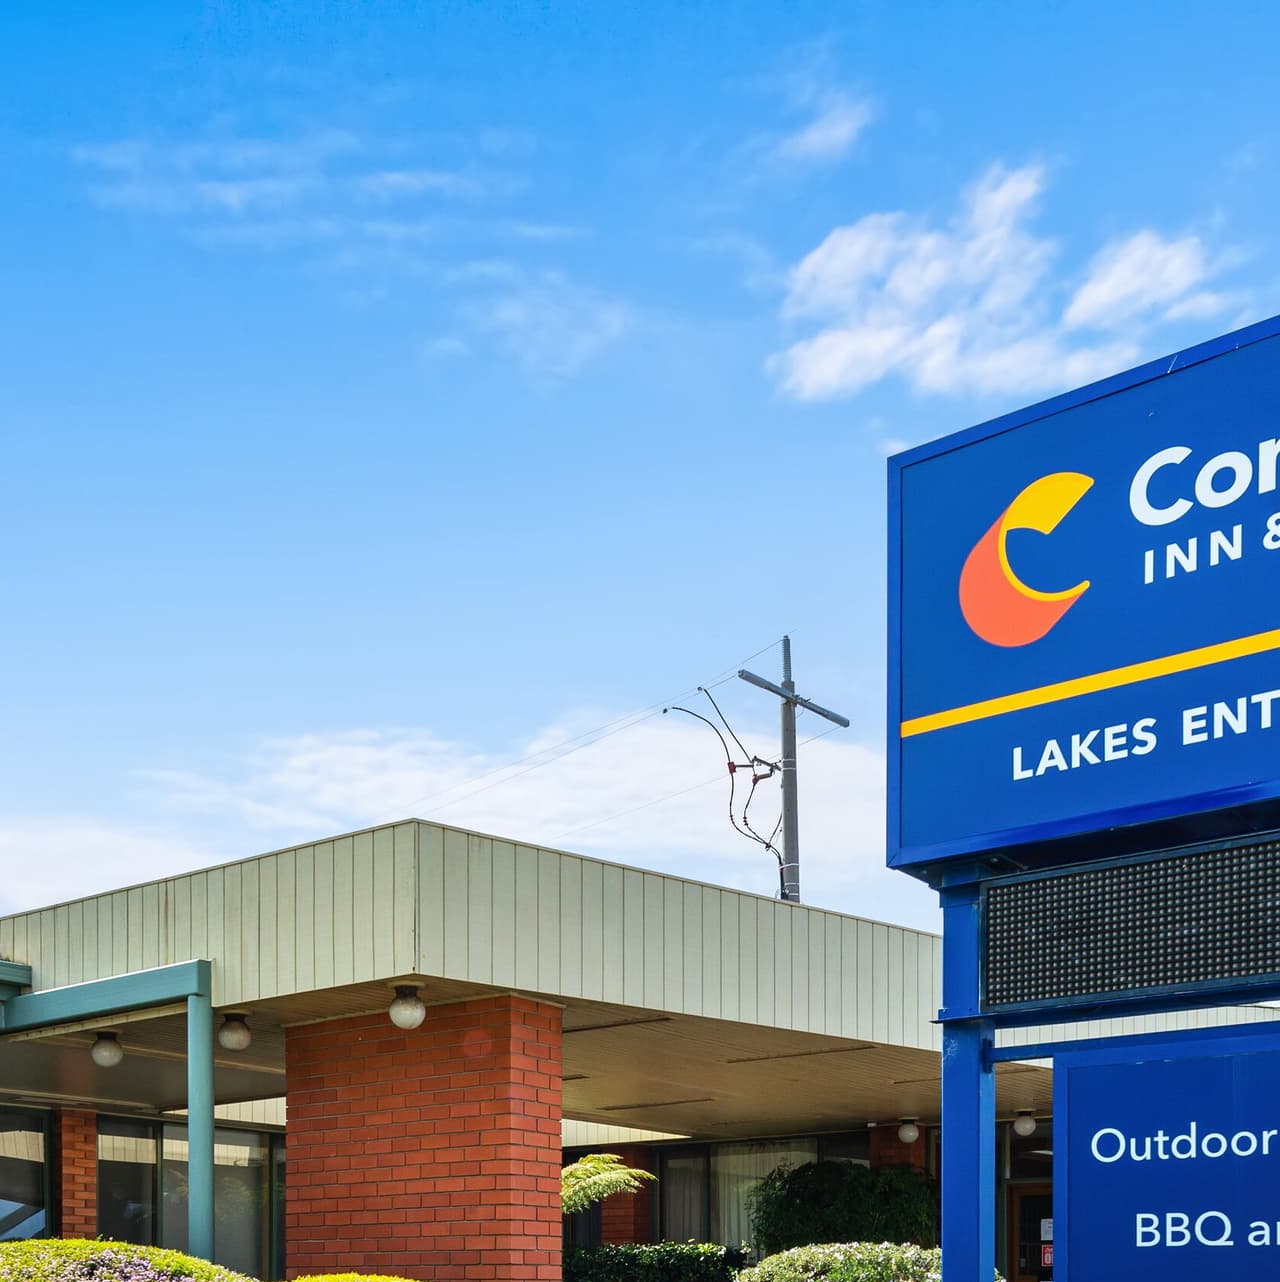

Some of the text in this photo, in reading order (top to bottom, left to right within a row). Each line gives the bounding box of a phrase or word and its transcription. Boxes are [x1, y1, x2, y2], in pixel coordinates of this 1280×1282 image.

[1144, 525, 1242, 584] INN
[1013, 719, 1157, 781] LAKES
[1091, 1122, 1278, 1163] Outdoor
[1136, 1211, 1234, 1247] BBQ
